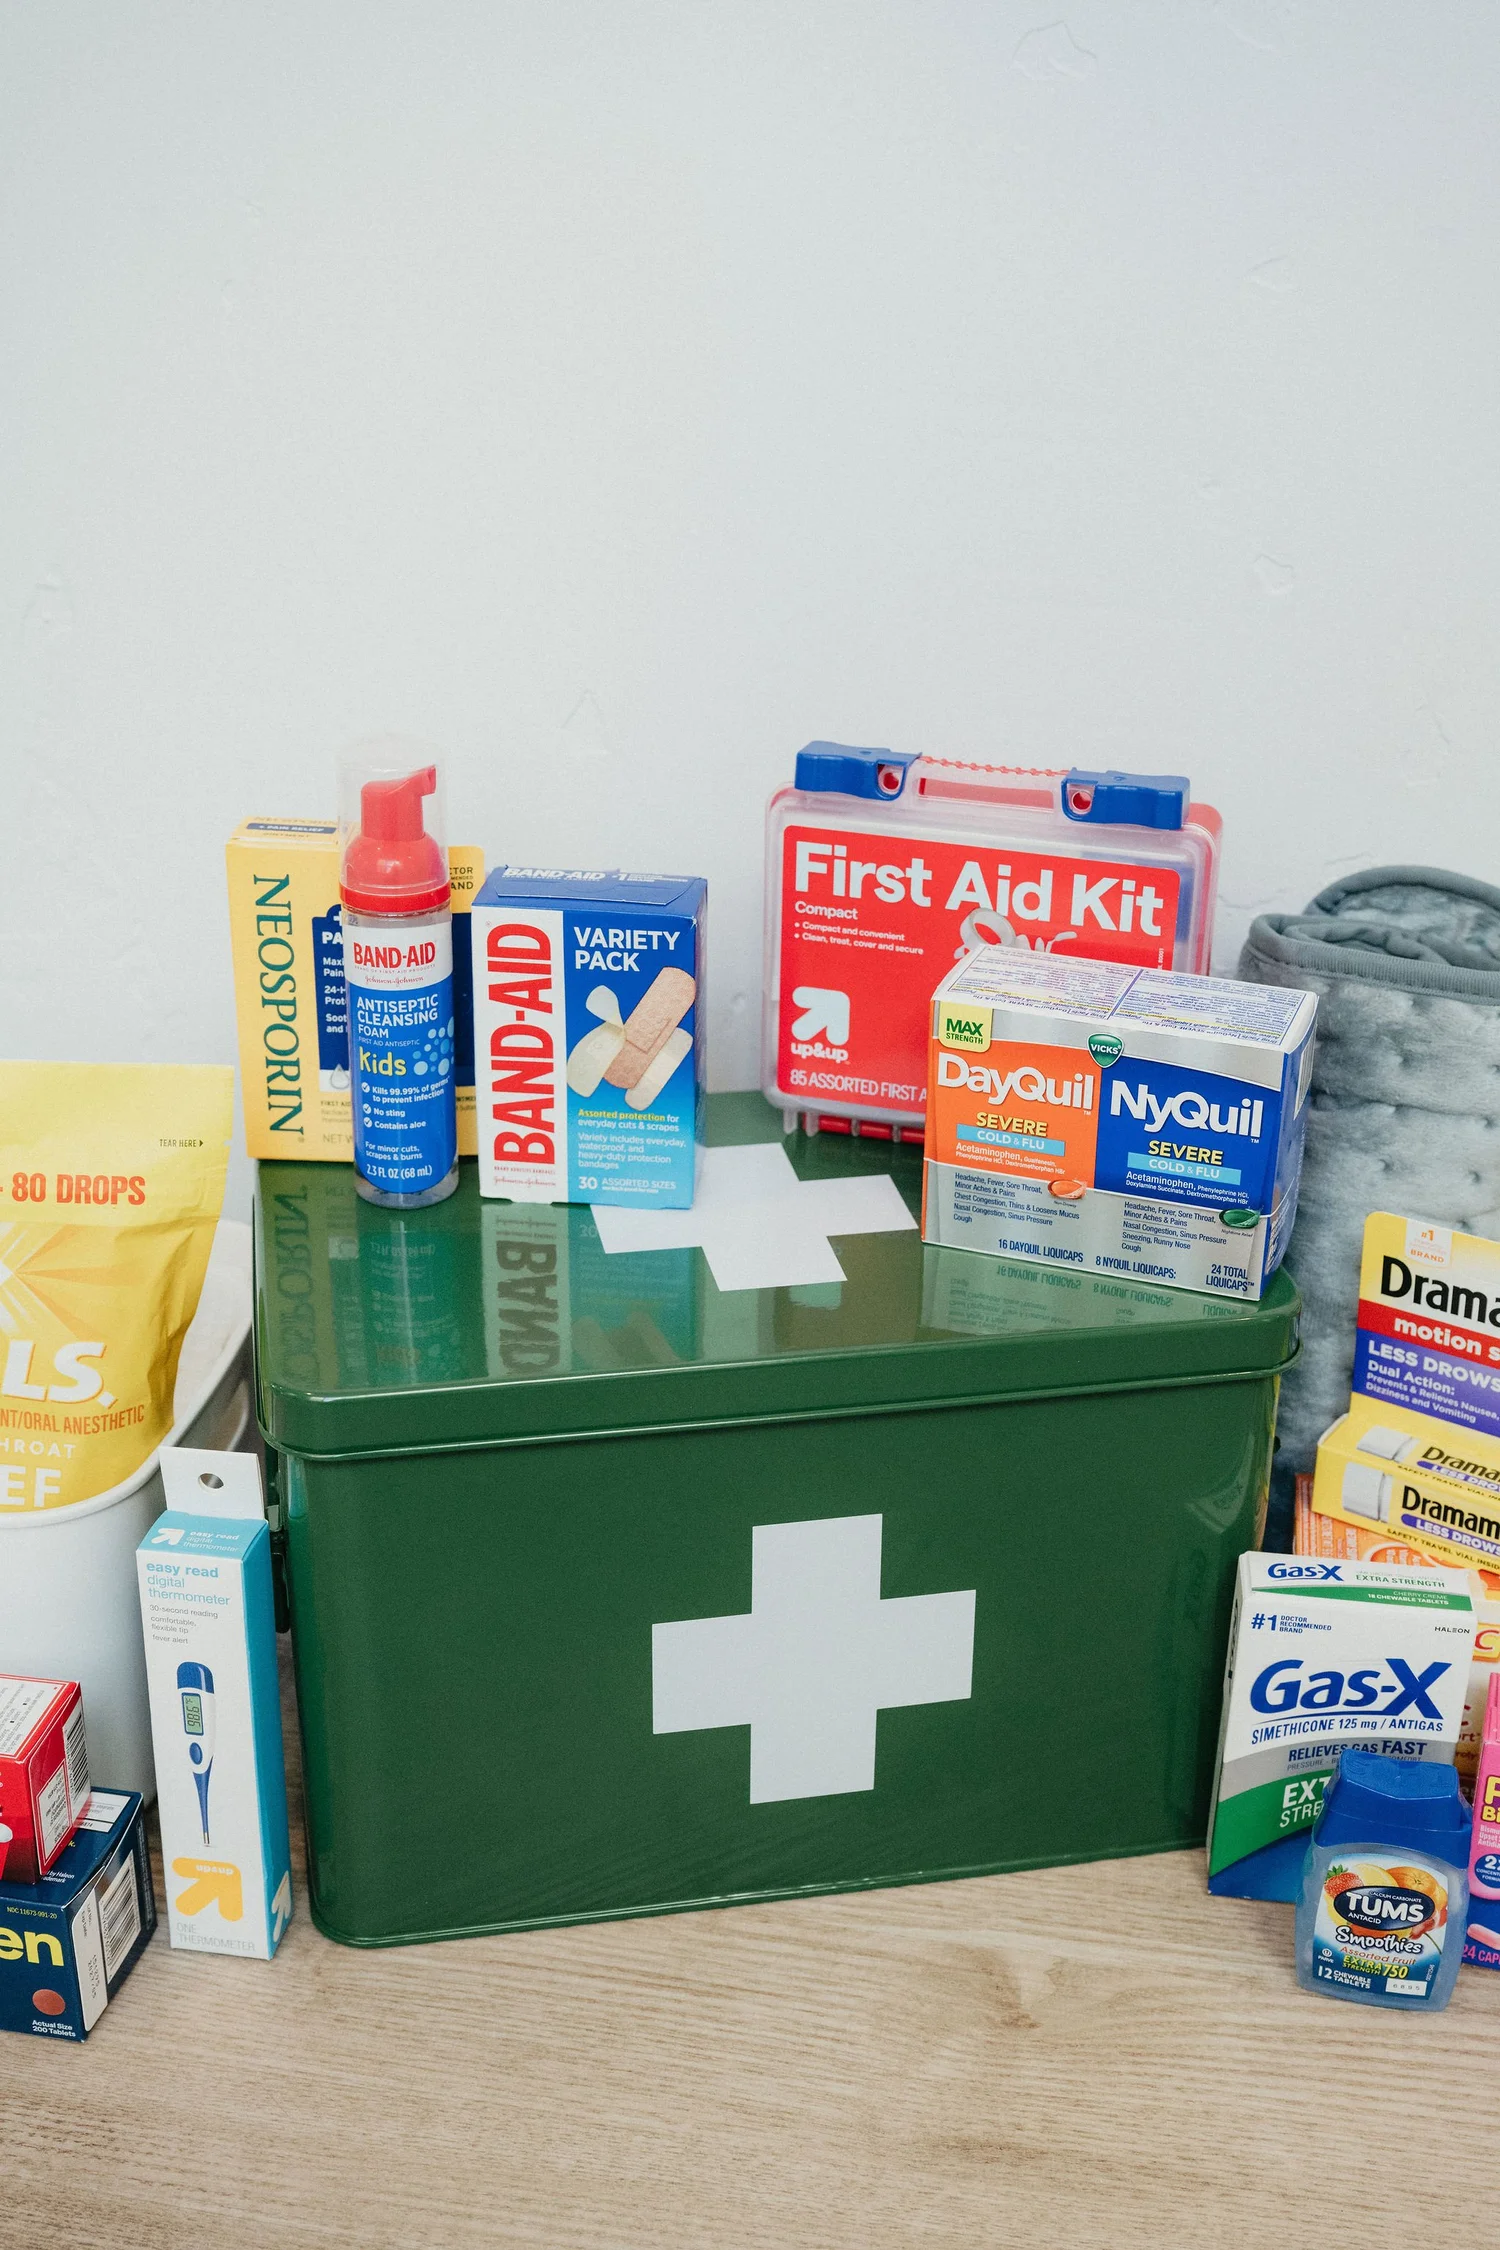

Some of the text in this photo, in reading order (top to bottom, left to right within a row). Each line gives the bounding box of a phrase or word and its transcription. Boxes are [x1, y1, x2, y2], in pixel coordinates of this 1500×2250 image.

[795, 841, 1164, 938] First Aid Kit
[794, 901, 859, 920] Compact
[574, 926, 680, 951] VARIETY
[802, 921, 905, 942] Compact and convenient
[353, 941, 436, 969] BAND-AID
[574, 950, 641, 972] PACK
[253, 874, 304, 1135] NEOSPORIN
[357, 993, 439, 1013] ANTISEPTIC
[358, 1008, 438, 1027] CLEANSING
[358, 1024, 389, 1039] FOAM
[945, 1018, 984, 1037] MAX
[486, 923, 556, 1165] BAND-AID
[945, 1032, 984, 1045] STRENGTH
[790, 1042, 849, 1063] up&up
[1090, 1043, 1119, 1055] VICKS
[790, 1068, 808, 1086] 85
[808, 1072, 879, 1096] ASSORTED
[881, 1081, 918, 1101] FIRST
[937, 1051, 1094, 1110] DayQuil
[373, 1107, 406, 1118] No sting
[578, 1109, 680, 1123] Assorted protection for
[1109, 1080, 1264, 1138] NyQuil
[374, 1121, 427, 1130] Contains aloe
[975, 1111, 1049, 1137] SEVERE
[159, 1138, 197, 1148] TEAR HERE
[977, 1130, 1045, 1150] COLD & FLU
[1148, 1139, 1224, 1166] SEVERE
[378, 1166, 387, 1178] FL
[388, 1168, 399, 1179] OZ
[401, 1168, 416, 1180] (68
[417, 1164, 433, 1177] mL)
[1148, 1158, 1220, 1179] COLD & FLU
[11, 1171, 147, 1206] 80 DROPS
[578, 1176, 598, 1190] 30
[601, 1178, 649, 1188] ASSORTED
[651, 1180, 677, 1190] SIZES
[954, 1181, 971, 1191] Minor
[972, 1184, 991, 1194] Aches
[999, 1188, 1016, 1198] Pains
[954, 1191, 1080, 1220] Chest Congestion, Thins & Loosens Mucus
[954, 1202, 1053, 1226] Nasal Congestion, Sinus Pressure
[953, 1213, 973, 1224] Cough
[1123, 1210, 1188, 1227] Minor Aches & Pains
[1122, 1220, 1227, 1245] Nasal Congestion, Sinus Pressure
[1421, 1229, 1435, 1242] #1
[999, 1238, 1084, 1263] 16 DAYQUIL LIQUICAPS
[1121, 1242, 1142, 1253] Cough
[1410, 1248, 1445, 1263] BRAND
[1095, 1256, 1176, 1279] 8 NYQUIL LIQUICAPS:
[1211, 1263, 1248, 1280] 24 TOTAL
[1394, 1317, 1482, 1357] motion
[1368, 1339, 1419, 1368] LESS
[1368, 1359, 1456, 1396] Dual Action:
[1365, 1381, 1477, 1424] Dizziness and Vomiting
[63, 1404, 145, 1436] ANESTHETIC
[1415, 1518, 1449, 1539] LESS
[146, 1562, 219, 1578] easy read
[1267, 1563, 1344, 1581] Gas-X
[147, 1575, 185, 1589] digital
[1356, 1574, 1390, 1584] EXTRA
[1392, 1577, 1446, 1588] STRENGTH
[148, 1587, 231, 1606] thermometer
[1251, 1613, 1278, 1631] #1
[1280, 1615, 1308, 1623] DOCTOR
[1280, 1621, 1332, 1631] RECOMMENDED
[1250, 1657, 1453, 1720] Gas-X
[1251, 1718, 1444, 1745] SIMETHICONE 125 mg / ANTIGAS
[1288, 1743, 1348, 1762] RELIEVES
[1381, 1740, 1428, 1756] FAST
[6, 1906, 20, 1915] NDC
[1345, 1891, 1424, 1923] TUMS
[1347, 1912, 1382, 1925] ANTACID
[178, 1934, 255, 1952] THERMOMETER
[1335, 1925, 1423, 1954] Smoothies
[1340, 1946, 1417, 1966] Assorted Fruit
[1343, 1954, 1382, 1971] EXTRA
[1317, 1965, 1333, 1980] 12
[1333, 1969, 1372, 1985] CHEWABLE
[1382, 1964, 1409, 1979] 750
[1333, 1976, 1371, 1989] TABLETS
[32, 2019, 73, 2031] Actual Size
[32, 2025, 77, 2038] 200 Tablets
